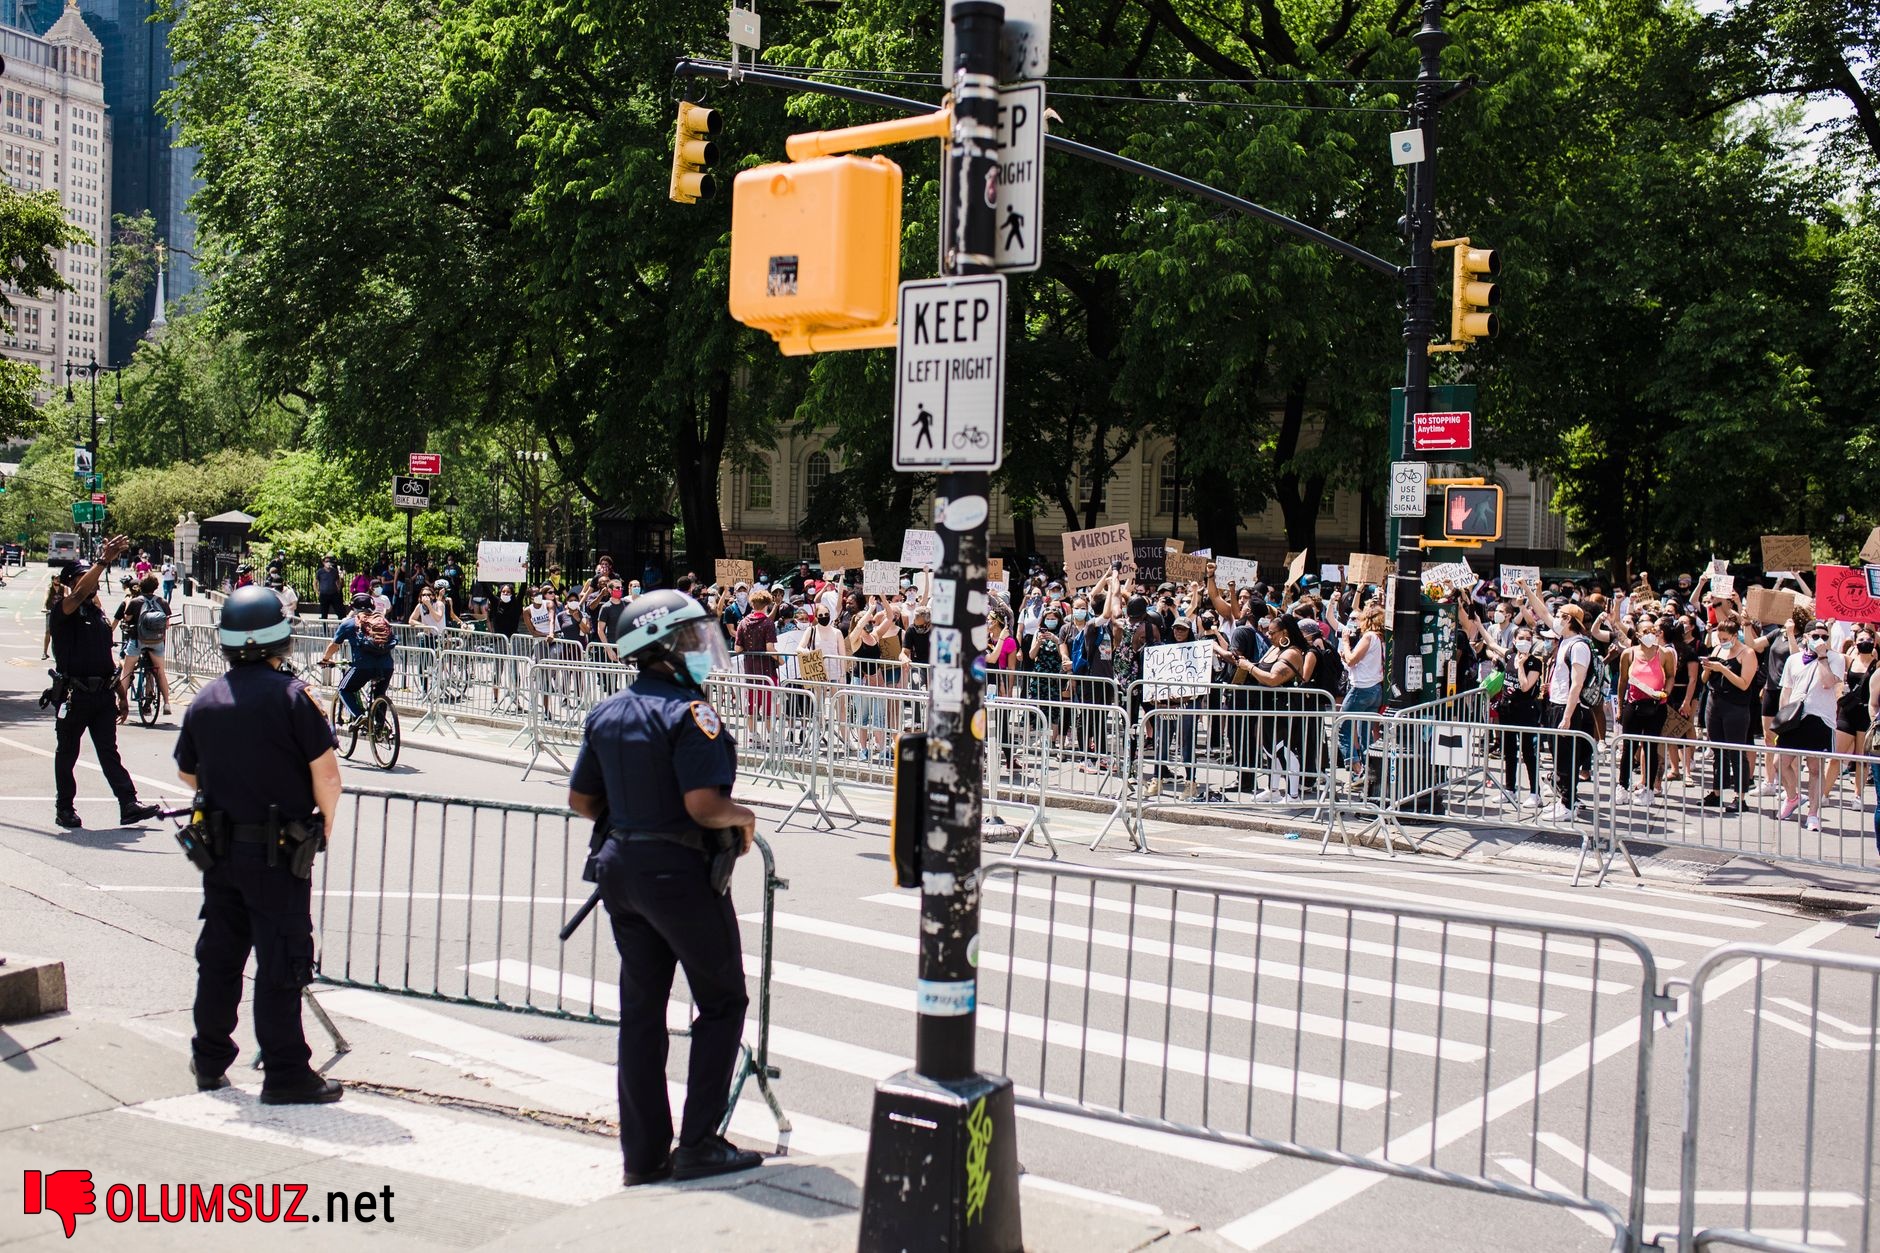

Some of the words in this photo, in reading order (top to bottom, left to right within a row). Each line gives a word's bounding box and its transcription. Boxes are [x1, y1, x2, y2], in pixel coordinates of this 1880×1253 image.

[914, 298, 989, 345] KEEP
[908, 360, 941, 382] LEFT
[952, 357, 993, 380] RIGHT
[1417, 417, 1427, 425] NO
[1428, 416, 1461, 425] STOPPING
[1417, 425, 1445, 433] Anytime
[397, 496, 410, 504] BIKE
[413, 498, 427, 506] LANE
[1393, 504, 1422, 512] SIGNAL
[1071, 529, 1127, 551] MURDER
[716, 560, 742, 570] BLACK
[1074, 552, 1129, 570] UNDERLYING
[726, 569, 749, 577] LIVES
[1135, 566, 1163, 581] PEACE
[1502, 568, 1521, 578] WHITE
[802, 651, 821, 664] BLACK
[1145, 644, 1212, 665] JUSTICE
[804, 662, 824, 674] LIVES
[1167, 659, 1197, 674] FOR
